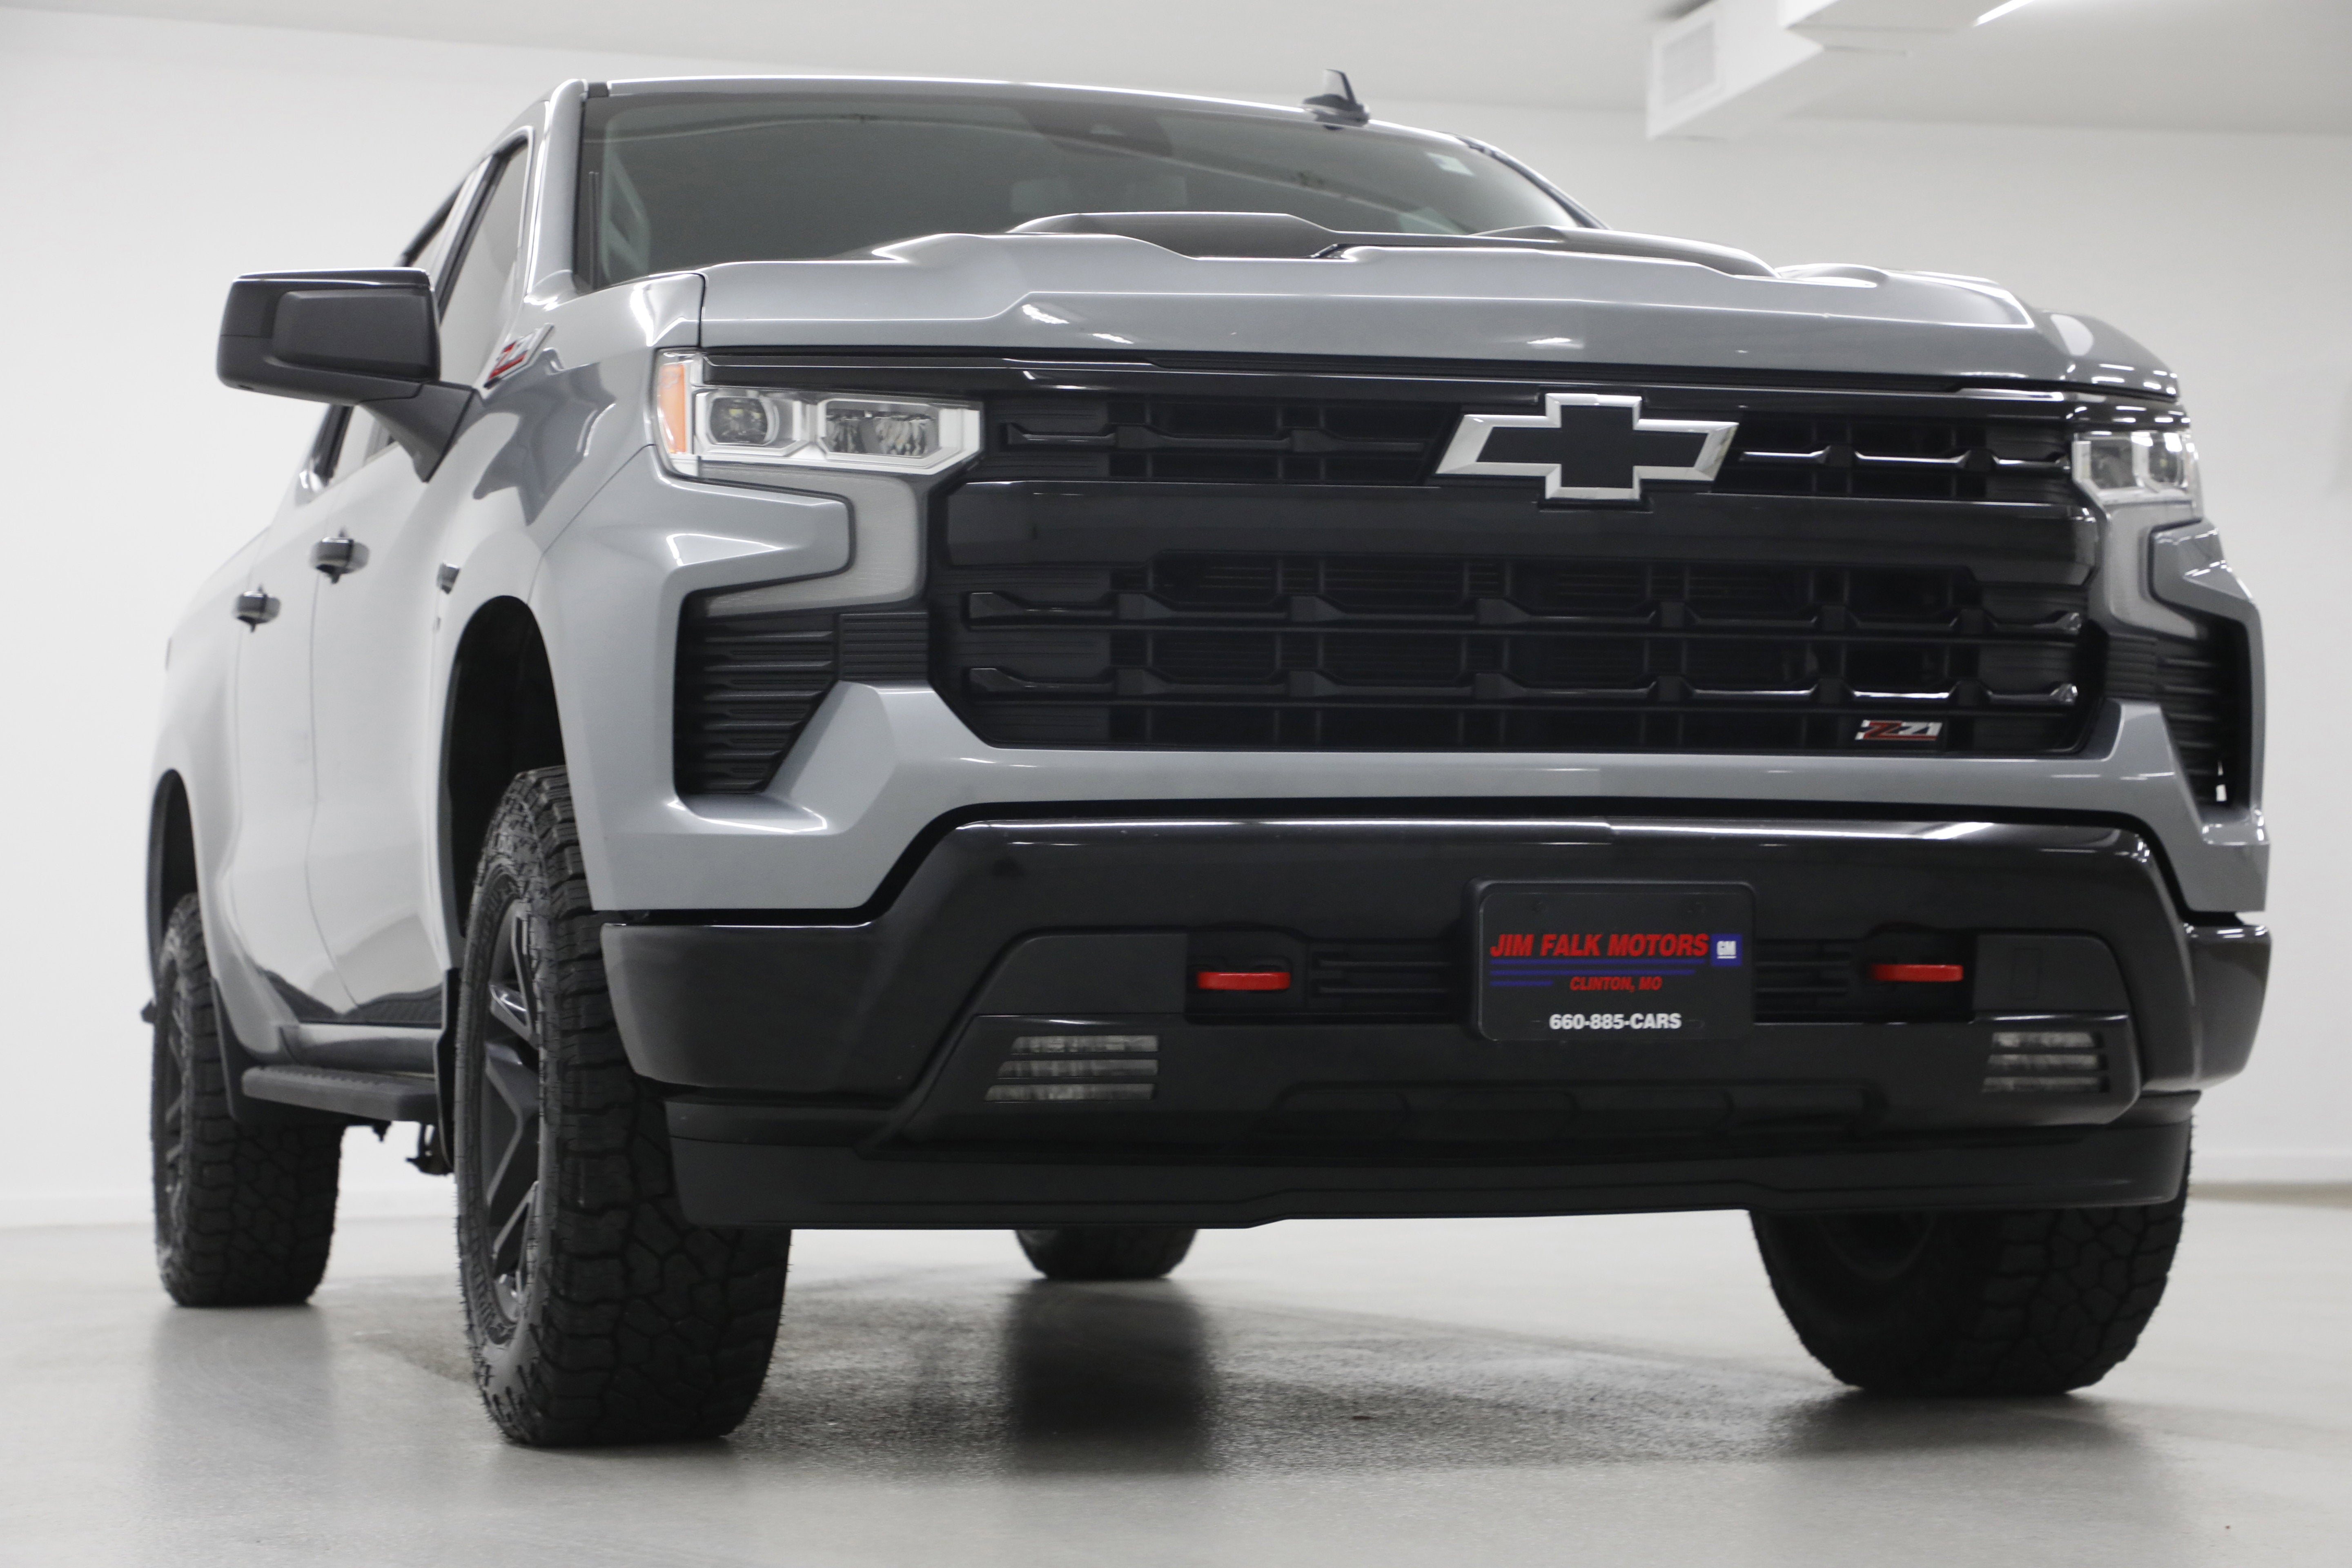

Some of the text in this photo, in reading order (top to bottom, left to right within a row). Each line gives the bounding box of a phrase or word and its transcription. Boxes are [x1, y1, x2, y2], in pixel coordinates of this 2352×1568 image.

[1855, 719, 1942, 740] Z71
[1490, 933, 1709, 957] JIM FALK MOTORS
[1570, 976, 1662, 993] CLINTON, MO
[1549, 1013, 1682, 1029] 660-885-CARS
